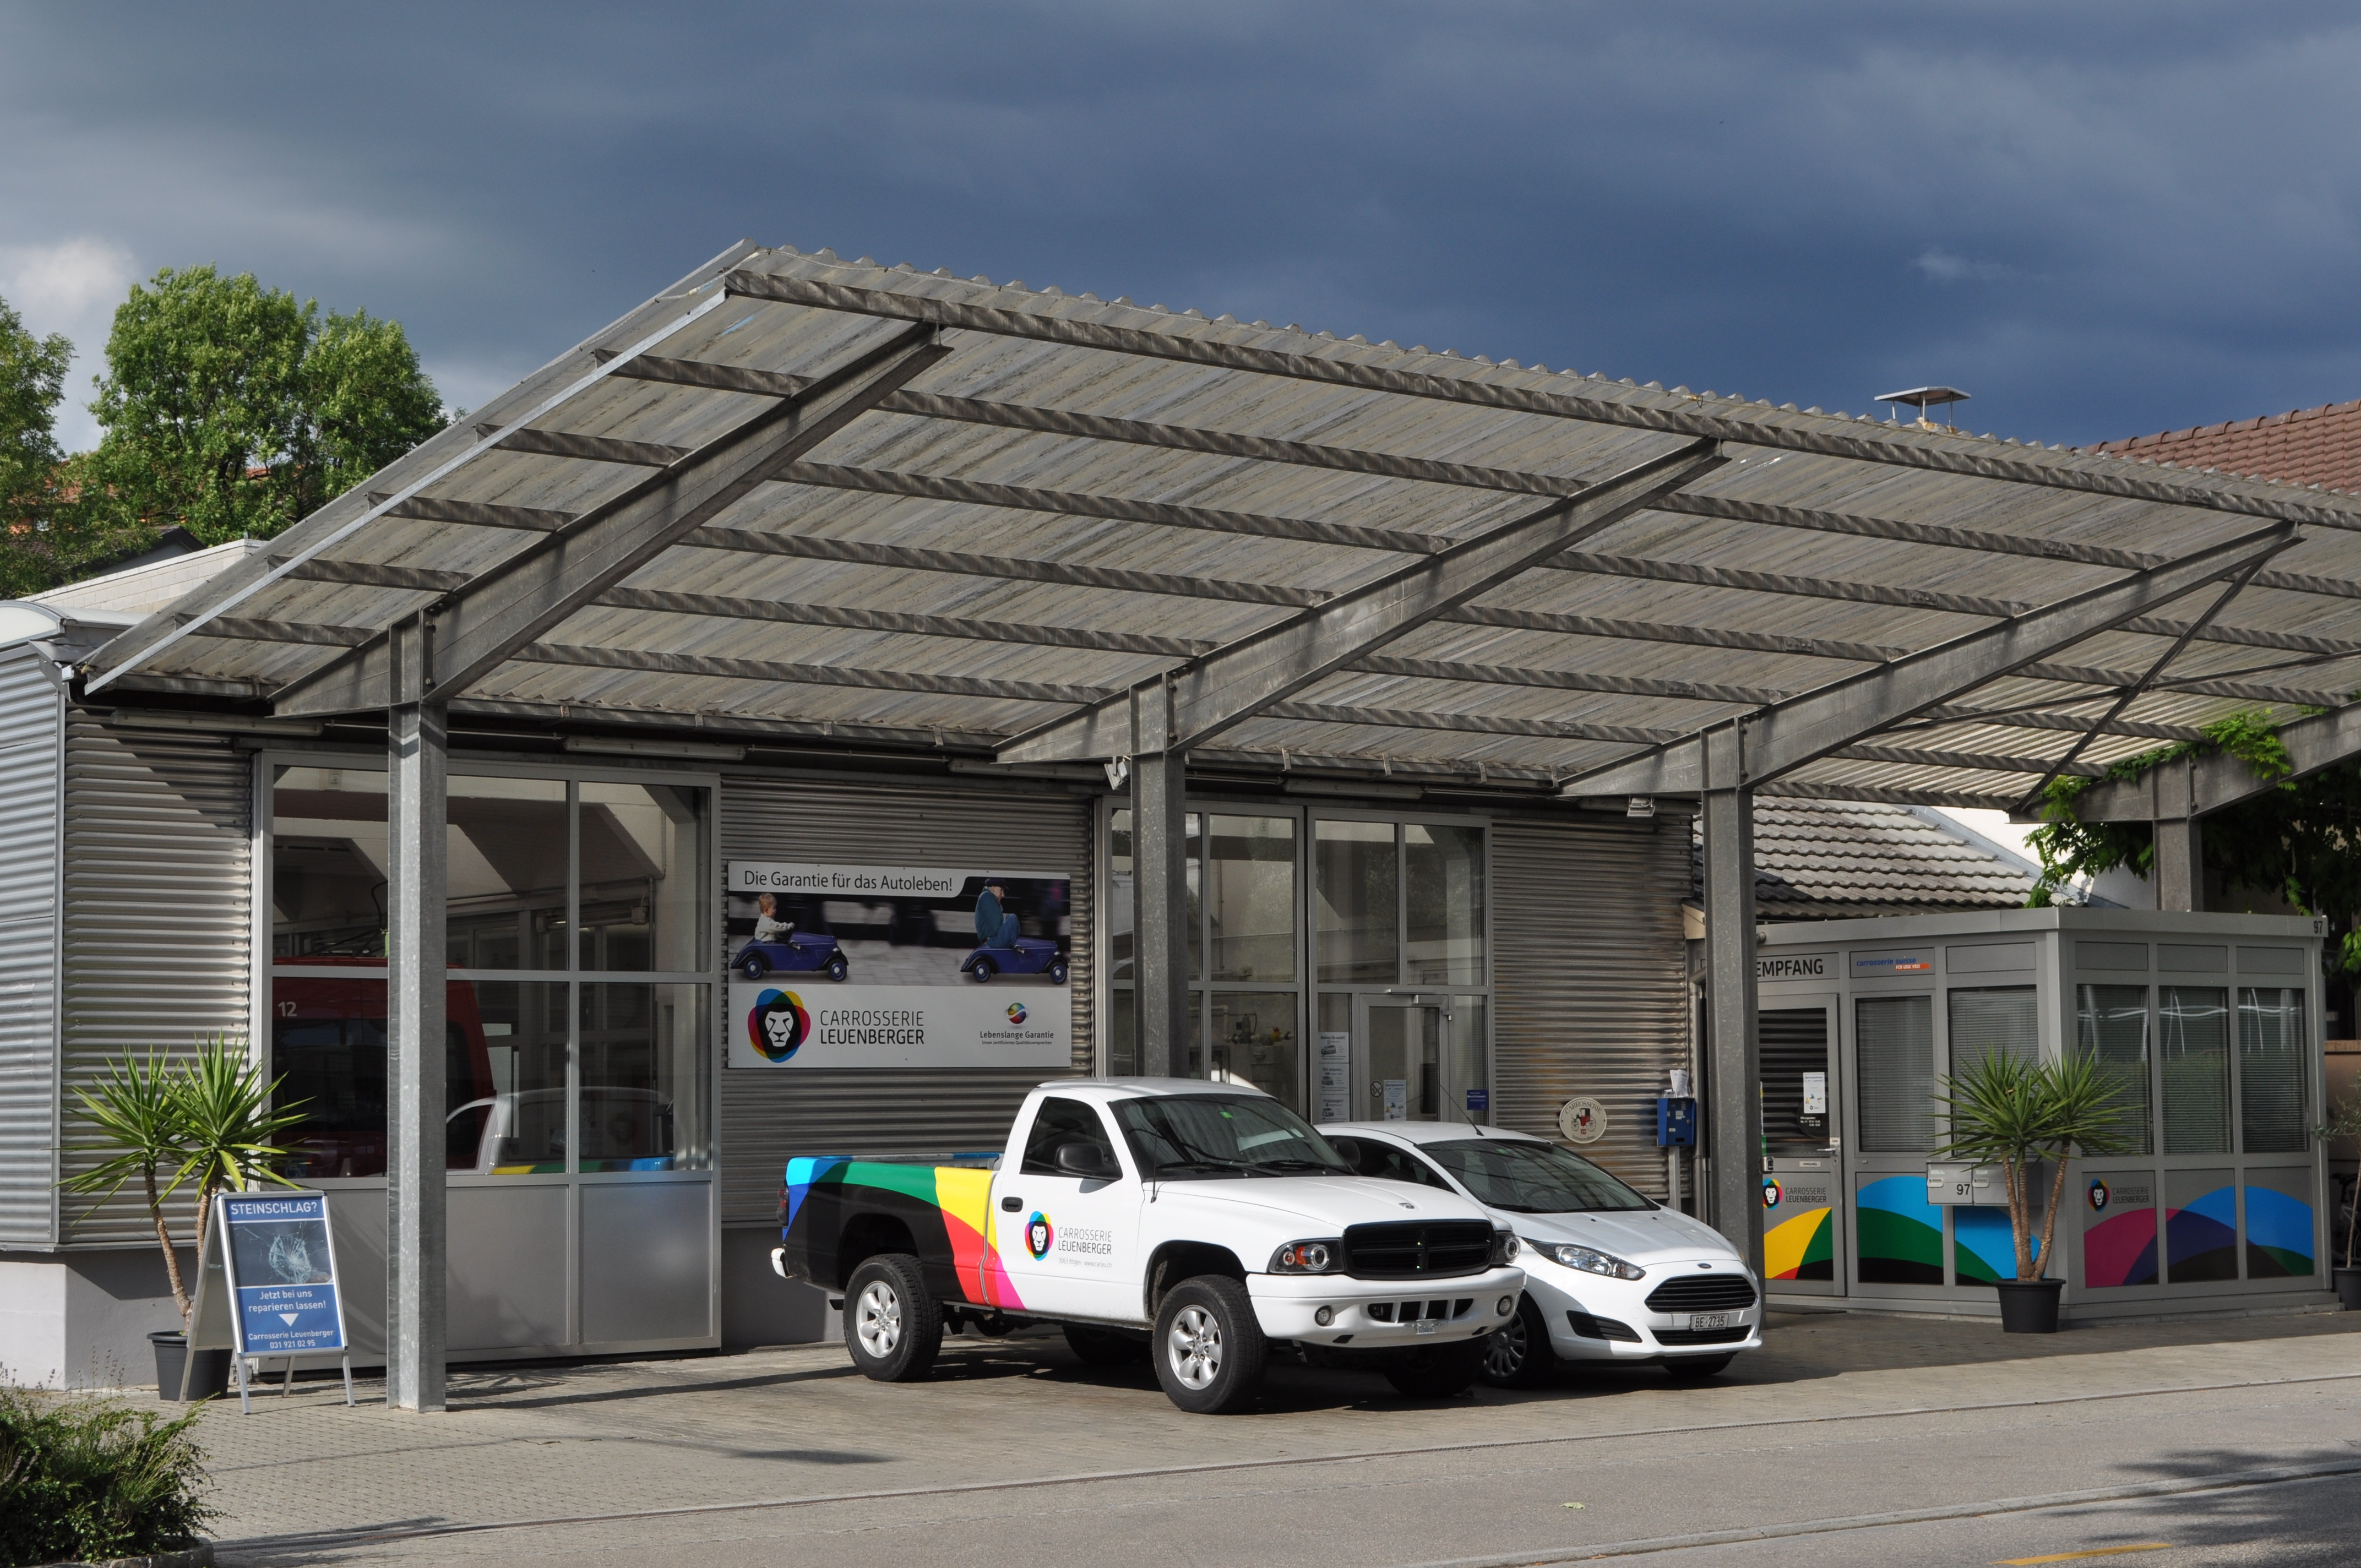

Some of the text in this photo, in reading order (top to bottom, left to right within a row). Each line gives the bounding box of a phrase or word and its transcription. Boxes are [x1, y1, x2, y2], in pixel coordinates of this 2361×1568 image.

[744, 870, 953, 891] Die Garantie für das Autoleben!
[1756, 959, 1823, 977] EMPFANG
[1856, 958, 1894, 966] carrosserie
[278, 1001, 297, 1017] 12
[820, 1010, 924, 1026] CARROSSERIE
[820, 1029, 924, 1045] LEUENBERGER
[980, 1031, 1023, 1039] Lebenslange
[1565, 1101, 1602, 1114] CARROSSERIE
[1956, 1184, 1971, 1195] 97
[2113, 1195, 2150, 1204] LEUENBERGER
[231, 1202, 318, 1215] STEINSCHLAG?
[1058, 1227, 1112, 1242] CARROSSERIE
[1058, 1240, 1112, 1255] LEUENBERGER
[260, 1290, 313, 1300] Jetzt bei uns
[248, 1300, 326, 1314] reparieren lassen!
[1695, 1316, 1724, 1327] BE 2735
[248, 1330, 334, 1341] Carrosserie Leuenberger
